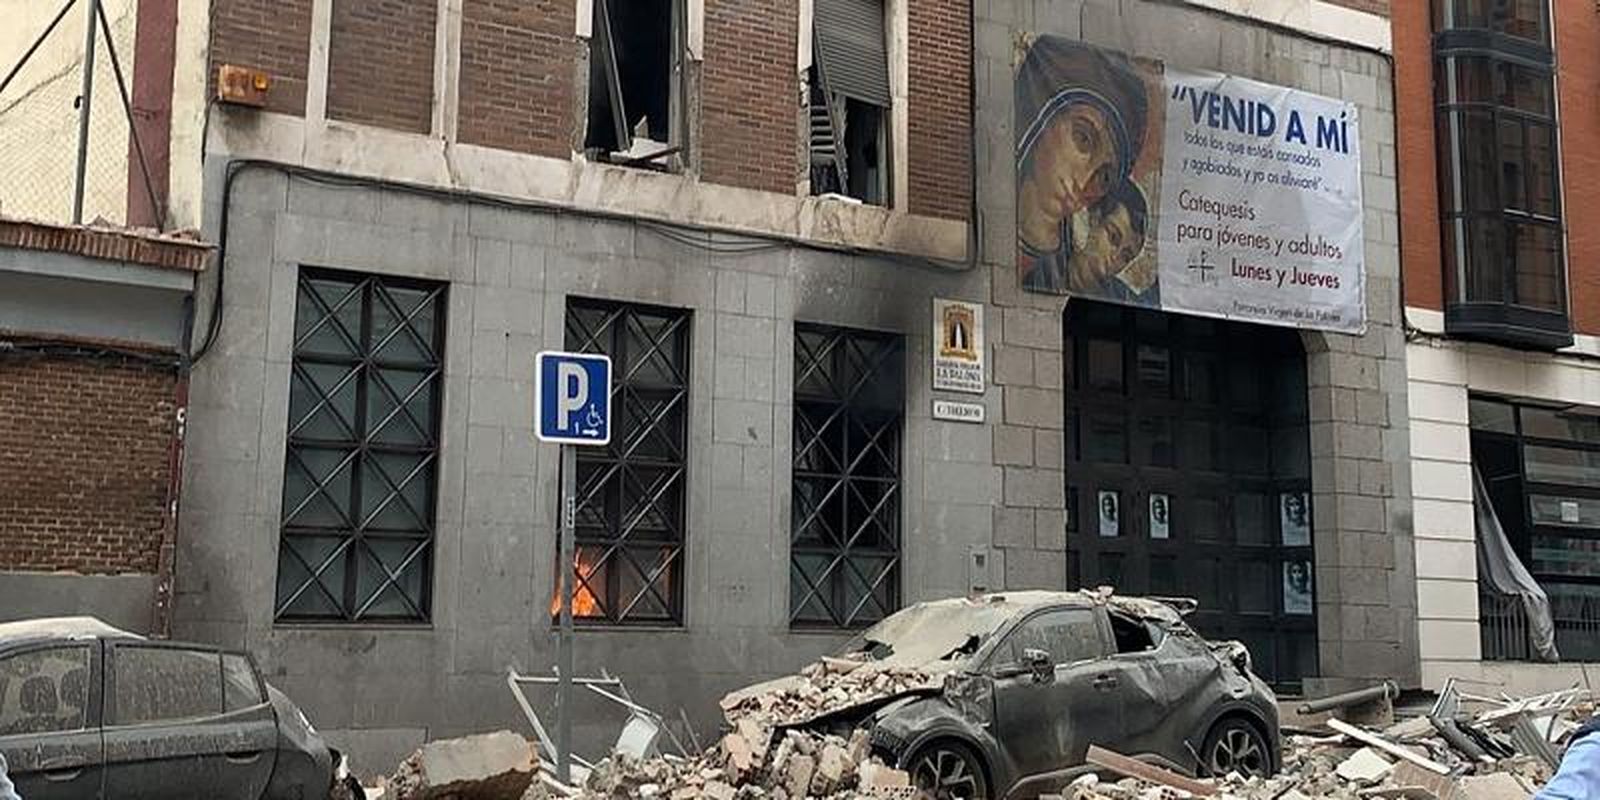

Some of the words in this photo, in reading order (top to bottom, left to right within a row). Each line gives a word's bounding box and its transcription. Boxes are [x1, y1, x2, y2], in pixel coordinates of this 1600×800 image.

[1285, 110, 1307, 145] A
[1316, 111, 1349, 154] MÍ
[1184, 131, 1208, 147] todos
[1210, 134, 1225, 151] los
[1227, 141, 1245, 157] que
[1276, 148, 1321, 168] cansados
[1189, 157, 1242, 176] agobiados
[1243, 169, 1250, 182] y
[1252, 170, 1265, 184] yo
[1267, 173, 1279, 184] os
[1178, 189, 1256, 221] Catequesis
[1177, 223, 1213, 243] para
[1216, 224, 1270, 251] jóvenes
[1274, 239, 1286, 256] y
[1288, 234, 1343, 260] adultos
[1231, 257, 1272, 281] Lunes
[1275, 268, 1286, 288] y
[1290, 266, 1341, 289] Jueves
[557, 361, 589, 431] P
[574, 422, 580, 435] 1
